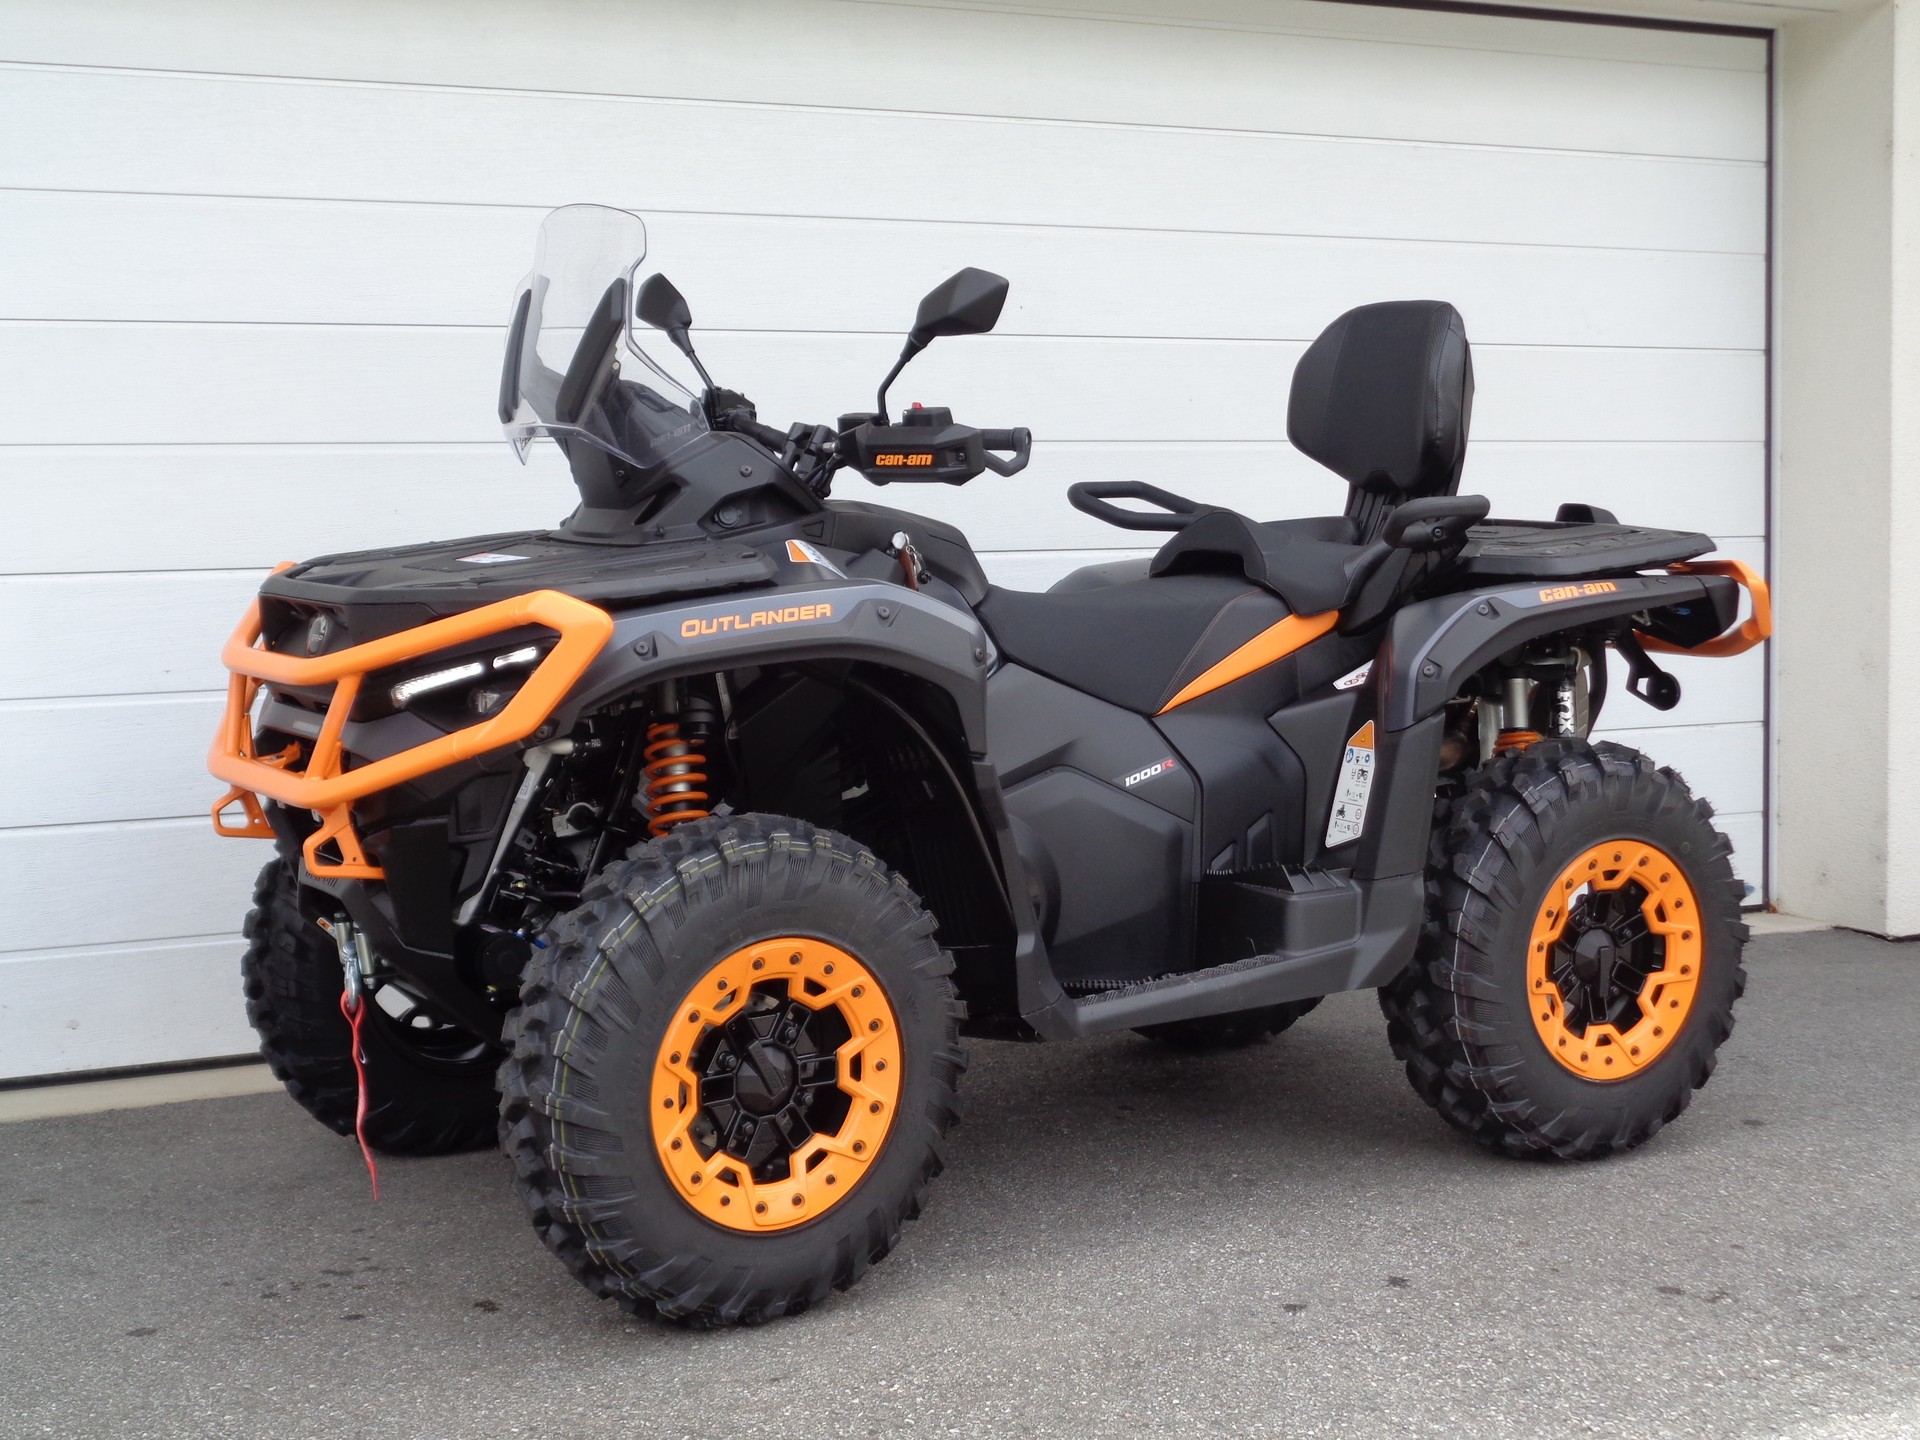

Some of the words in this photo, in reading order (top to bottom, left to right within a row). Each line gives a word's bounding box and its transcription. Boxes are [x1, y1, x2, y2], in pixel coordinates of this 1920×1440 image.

[875, 454, 932, 466] can-am
[1539, 581, 1617, 602] can-am
[681, 603, 831, 637] OUTLANDER
[1125, 759, 1174, 787] 1000R
